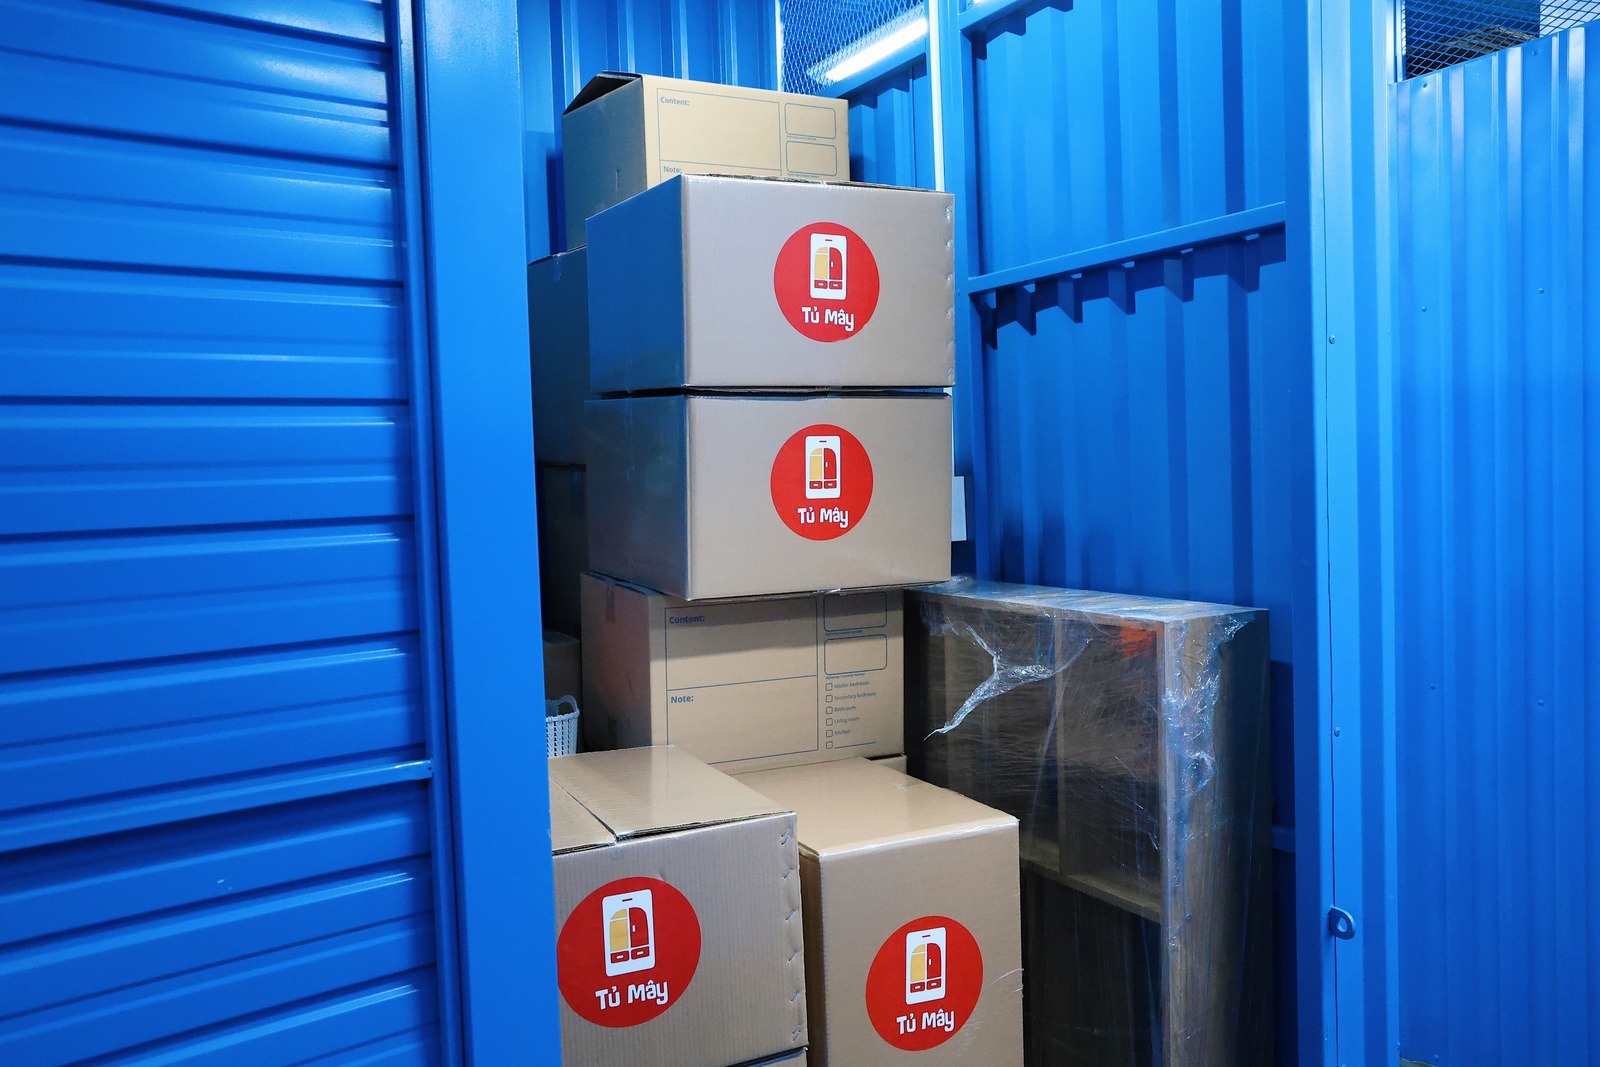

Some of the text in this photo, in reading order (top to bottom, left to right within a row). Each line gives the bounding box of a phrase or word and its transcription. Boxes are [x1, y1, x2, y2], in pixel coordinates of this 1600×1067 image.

[660, 96, 690, 106] Content:
[663, 166, 683, 174] Note:
[802, 305, 855, 332] Tủ Mây
[798, 506, 848, 529] Tủ Mây
[669, 615, 704, 624] Content:
[671, 695, 694, 703] Note:
[595, 980, 669, 1010] Tủ Mây
[896, 1009, 955, 1035] Tủ Mây
